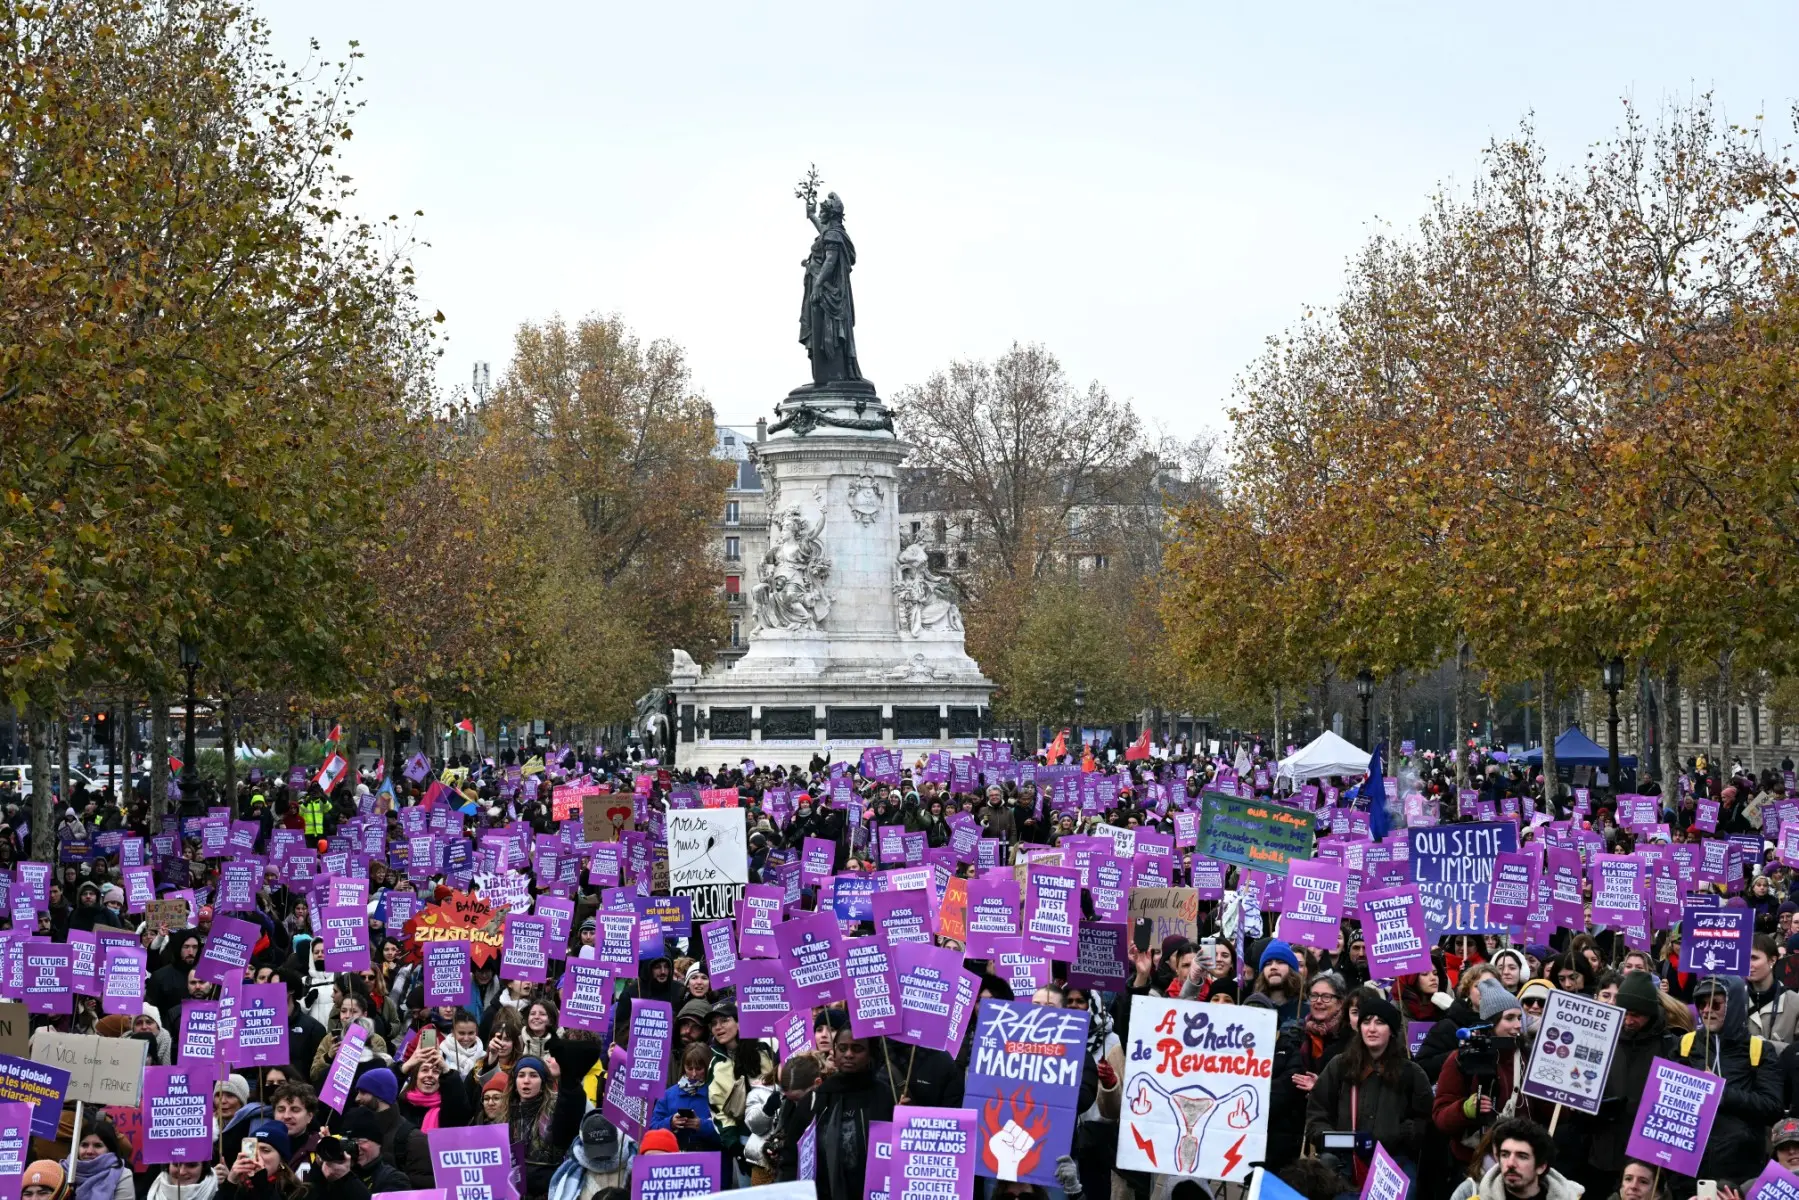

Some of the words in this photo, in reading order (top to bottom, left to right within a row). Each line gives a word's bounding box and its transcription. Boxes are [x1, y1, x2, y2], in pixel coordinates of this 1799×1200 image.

[1139, 844, 1168, 854] CULTURE
[1416, 832, 1446, 854] QUI
[903, 872, 928, 881] HOMME
[1032, 874, 1076, 889] L'EXTRÊME
[912, 881, 925, 889] UNE
[1294, 876, 1340, 892] CULTURE
[1038, 888, 1067, 900] DROITE
[1308, 890, 1322, 902] DU
[456, 900, 492, 916] BANDE
[655, 899, 671, 908] L'IVG
[748, 898, 778, 910] CULTURE
[1041, 900, 1064, 910] N'EST
[1301, 902, 1324, 914] VIOL
[1364, 894, 1414, 911] L'EXTRÊME
[891, 908, 912, 918] ASSOS
[1036, 910, 1066, 923] JAMAIS
[1286, 911, 1337, 924] CONSENTEMENT
[1374, 908, 1408, 921] DROITE
[328, 918, 362, 929] CULTURE
[464, 915, 480, 924] DE
[1380, 920, 1406, 931] N'EST
[340, 928, 352, 936] DU
[1031, 922, 1072, 936] FÉMINISTE
[100, 937, 136, 947] L'EXTRÊME
[1378, 930, 1412, 943] JAMAIS
[791, 940, 830, 956] VICTIMES
[848, 945, 878, 957] VIOLENCE
[1374, 938, 1420, 955] FÉMINISTE
[29, 957, 66, 966] CULTURE
[204, 951, 246, 967] ABANDONNÉES
[42, 968, 54, 976] DU
[570, 965, 610, 978] L'EXTRÊME
[914, 966, 940, 979] ASSOS
[38, 978, 58, 986] VIOL
[576, 976, 602, 986] DROITE
[753, 977, 774, 986] ASSOS
[856, 976, 883, 986] SILENCE
[900, 974, 950, 992] DÉFINANCÉES
[578, 984, 598, 994] N'EST
[744, 984, 785, 994] DÉFINANCÉES
[855, 985, 888, 997] COMPLICE
[904, 986, 940, 1001] VICTIMES
[574, 993, 600, 1003] JAMAIS
[567, 1000, 604, 1013] FÉMINISTE
[742, 1002, 789, 1011] ABANDONNÉES
[858, 1006, 894, 1019] COUPABLE
[1556, 998, 1594, 1017] VENTE
[1595, 1008, 1612, 1022] DE
[190, 1012, 204, 1020] QUI
[240, 1008, 276, 1018] VICTIMES
[640, 1008, 664, 1020] VIOLENCE
[188, 1022, 198, 1030] LA
[198, 1023, 216, 1032] MISÈ
[980, 1002, 1088, 1046] RAGE
[1556, 1012, 1608, 1033] GOODIES
[1154, 1009, 1177, 1035] A
[1182, 1012, 1256, 1051] Chatte
[638, 1039, 661, 1050] SILENCE
[980, 1036, 998, 1048] THE
[184, 1046, 195, 1054] LA
[634, 1048, 662, 1059] COMPLICE
[1008, 1042, 1062, 1056] against
[1130, 1039, 1153, 1061] de
[1156, 1038, 1272, 1078] Revanche
[975, 1047, 1079, 1086] MACHISM
[8, 1064, 20, 1076] loi
[20, 1066, 52, 1085] globale
[170, 1075, 186, 1084] IVG
[632, 1068, 660, 1081] COUPABLE
[1659, 1068, 1674, 1080] UN
[1674, 1072, 1712, 1092] HOMME
[6, 1078, 20, 1090] les
[20, 1080, 60, 1100] violences
[100, 1079, 132, 1093] FRANCE
[168, 1086, 188, 1095] PMA
[1664, 1082, 1682, 1096] TUE
[1682, 1087, 1704, 1102] UNE
[152, 1096, 204, 1106] TRANSITION
[1554, 1090, 1568, 1102] ICI
[1662, 1094, 1697, 1114] FEMME
[154, 1108, 174, 1117] MON
[174, 1107, 204, 1116] CORPS
[1653, 1104, 1679, 1121] TOUS
[1680, 1112, 1699, 1128] LES
[154, 1118, 175, 1127] MON
[176, 1117, 203, 1127] CHOIX
[911, 1118, 958, 1130] VIOLENCE
[1646, 1115, 1664, 1129] 2,5
[1664, 1120, 1696, 1140] JOURS
[150, 1129, 169, 1138] MES
[170, 1128, 201, 1138] DROITS
[901, 1128, 922, 1139] AUX
[923, 1130, 966, 1142] ENFANTS
[1642, 1126, 1656, 1139] EN
[1656, 1130, 1696, 1152] FRANCE
[900, 1140, 912, 1151] ET
[914, 1141, 936, 1152] AUX
[936, 1142, 966, 1154] ADOS
[442, 1150, 499, 1166] CULTURE
[912, 1155, 952, 1168] SILENCE
[464, 1170, 480, 1182] DU
[652, 1166, 701, 1178] VIOLENCE
[906, 1166, 958, 1180] COMPLICE
[642, 1180, 664, 1191] AUX
[665, 1178, 711, 1190] ENFANTS
[904, 1191, 958, 1200] COUPABLE
